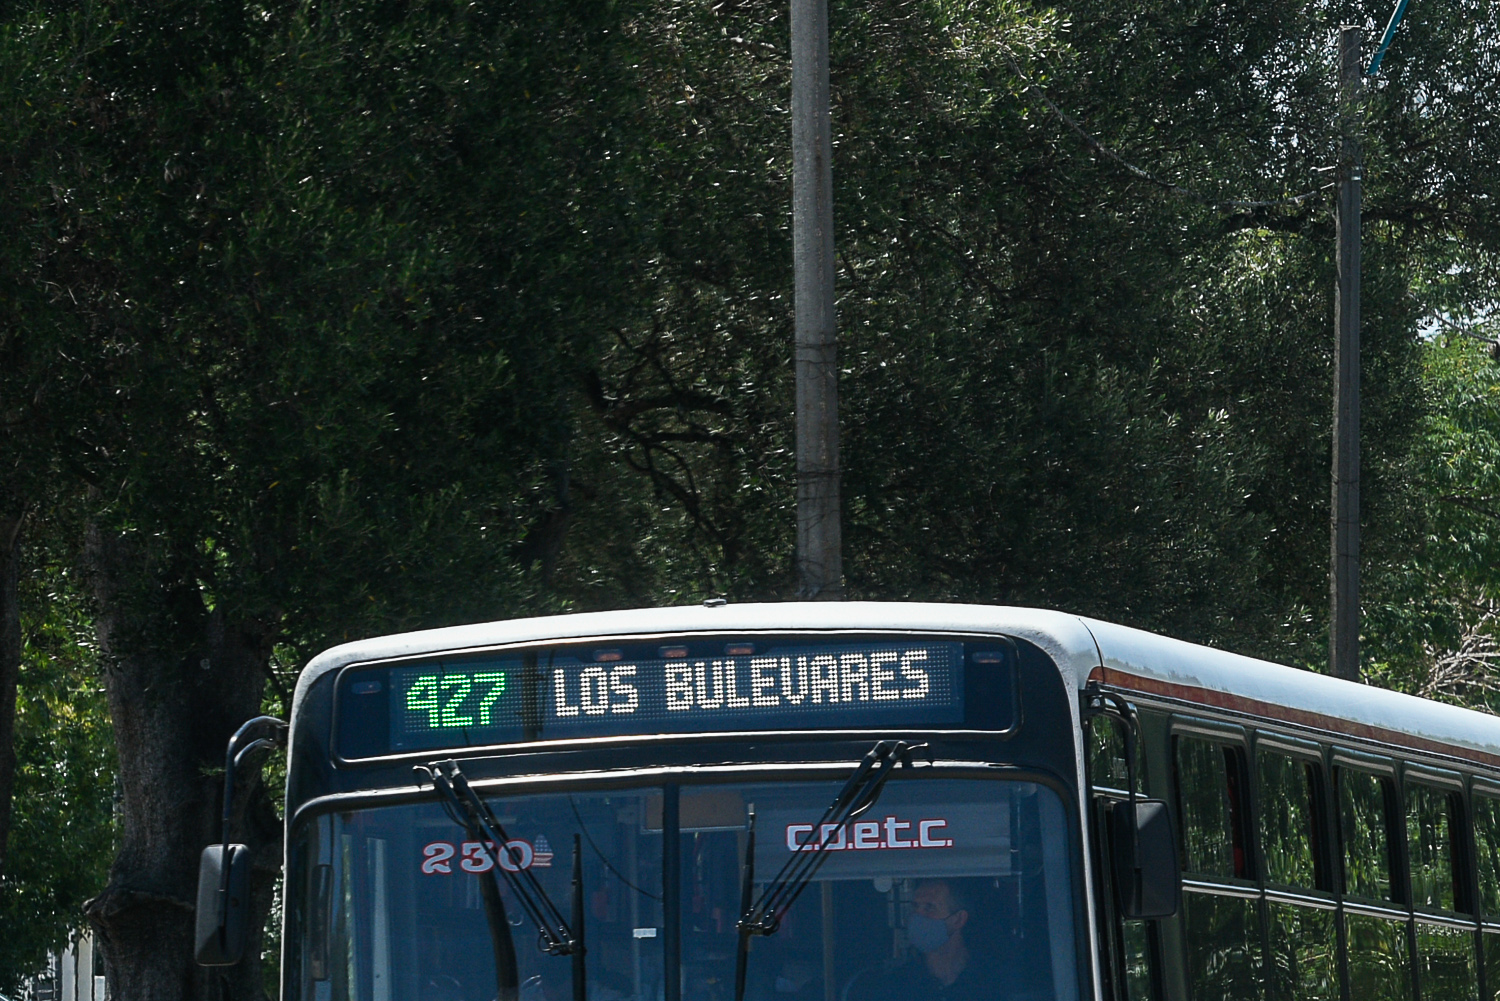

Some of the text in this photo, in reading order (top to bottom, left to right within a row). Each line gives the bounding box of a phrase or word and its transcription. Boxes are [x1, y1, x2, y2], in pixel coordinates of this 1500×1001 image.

[406, 649, 930, 728] 427 LOS BULEVARES
[422, 839, 535, 875] 230
